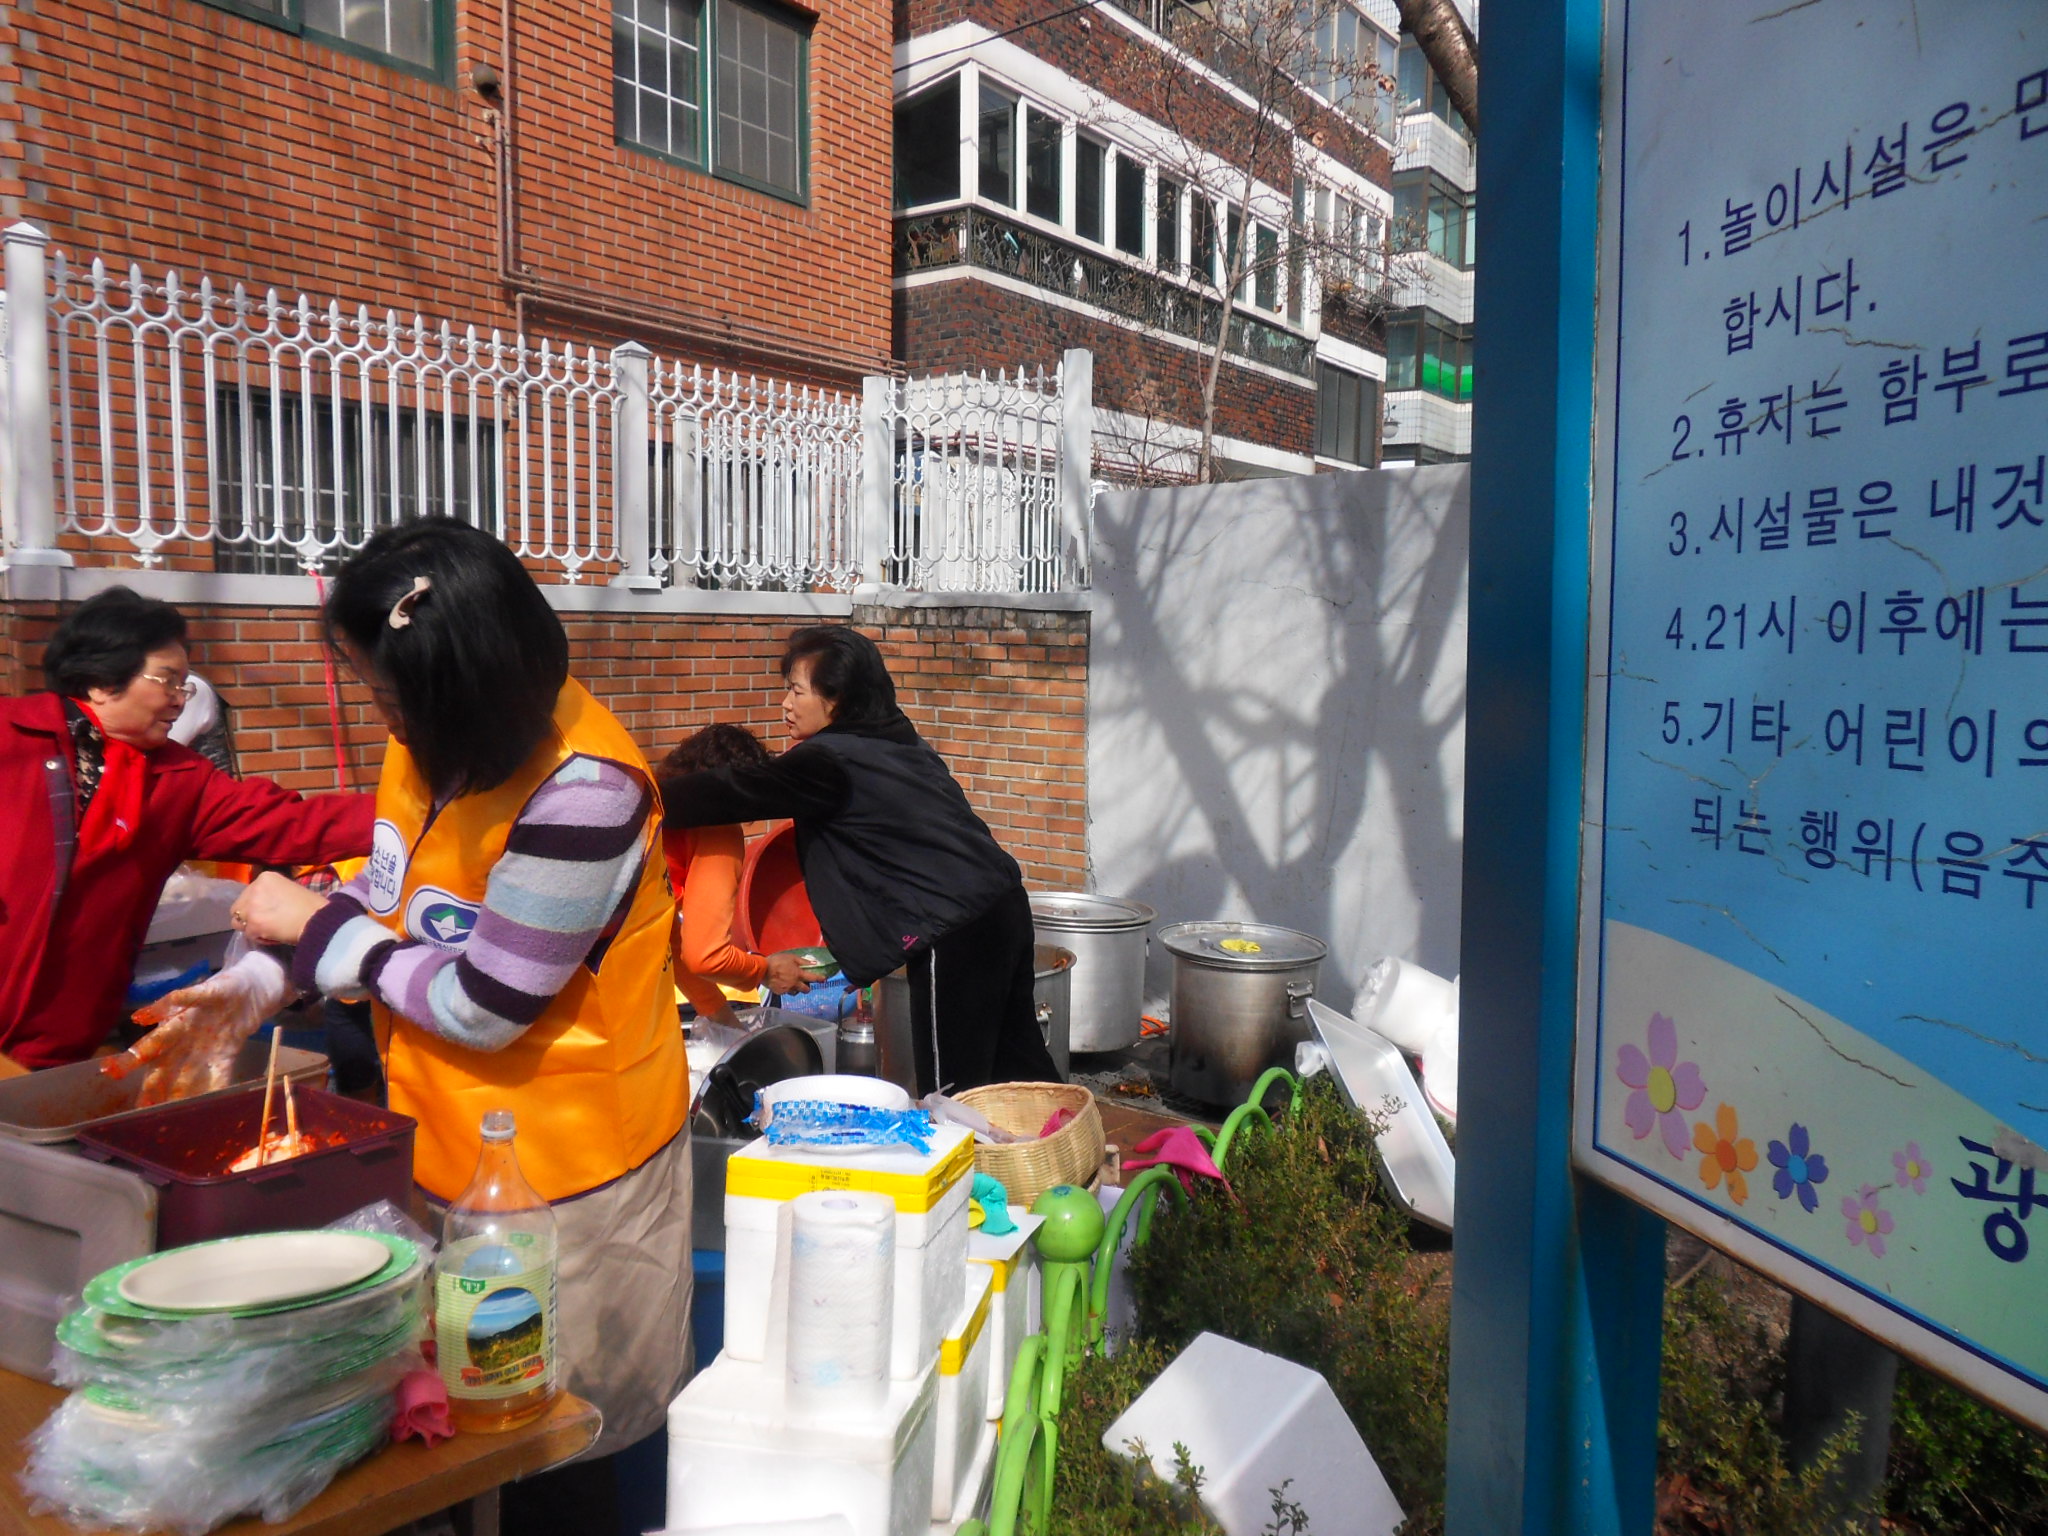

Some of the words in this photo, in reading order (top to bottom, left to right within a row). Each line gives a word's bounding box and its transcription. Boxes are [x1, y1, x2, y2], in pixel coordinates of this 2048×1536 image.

[1679, 102, 1975, 266] 1.놀이시설은
[1723, 258, 1876, 355] 합시다.
[1672, 380, 1848, 462] 2.휴지는
[1879, 331, 2048, 425] 함부로
[1669, 480, 1898, 556] 3.시설물은
[1665, 595, 1797, 655] 4.21시
[1827, 586, 2048, 655] 이후에는
[1662, 698, 1790, 757] 5.기타
[1690, 795, 1772, 854] 되는
